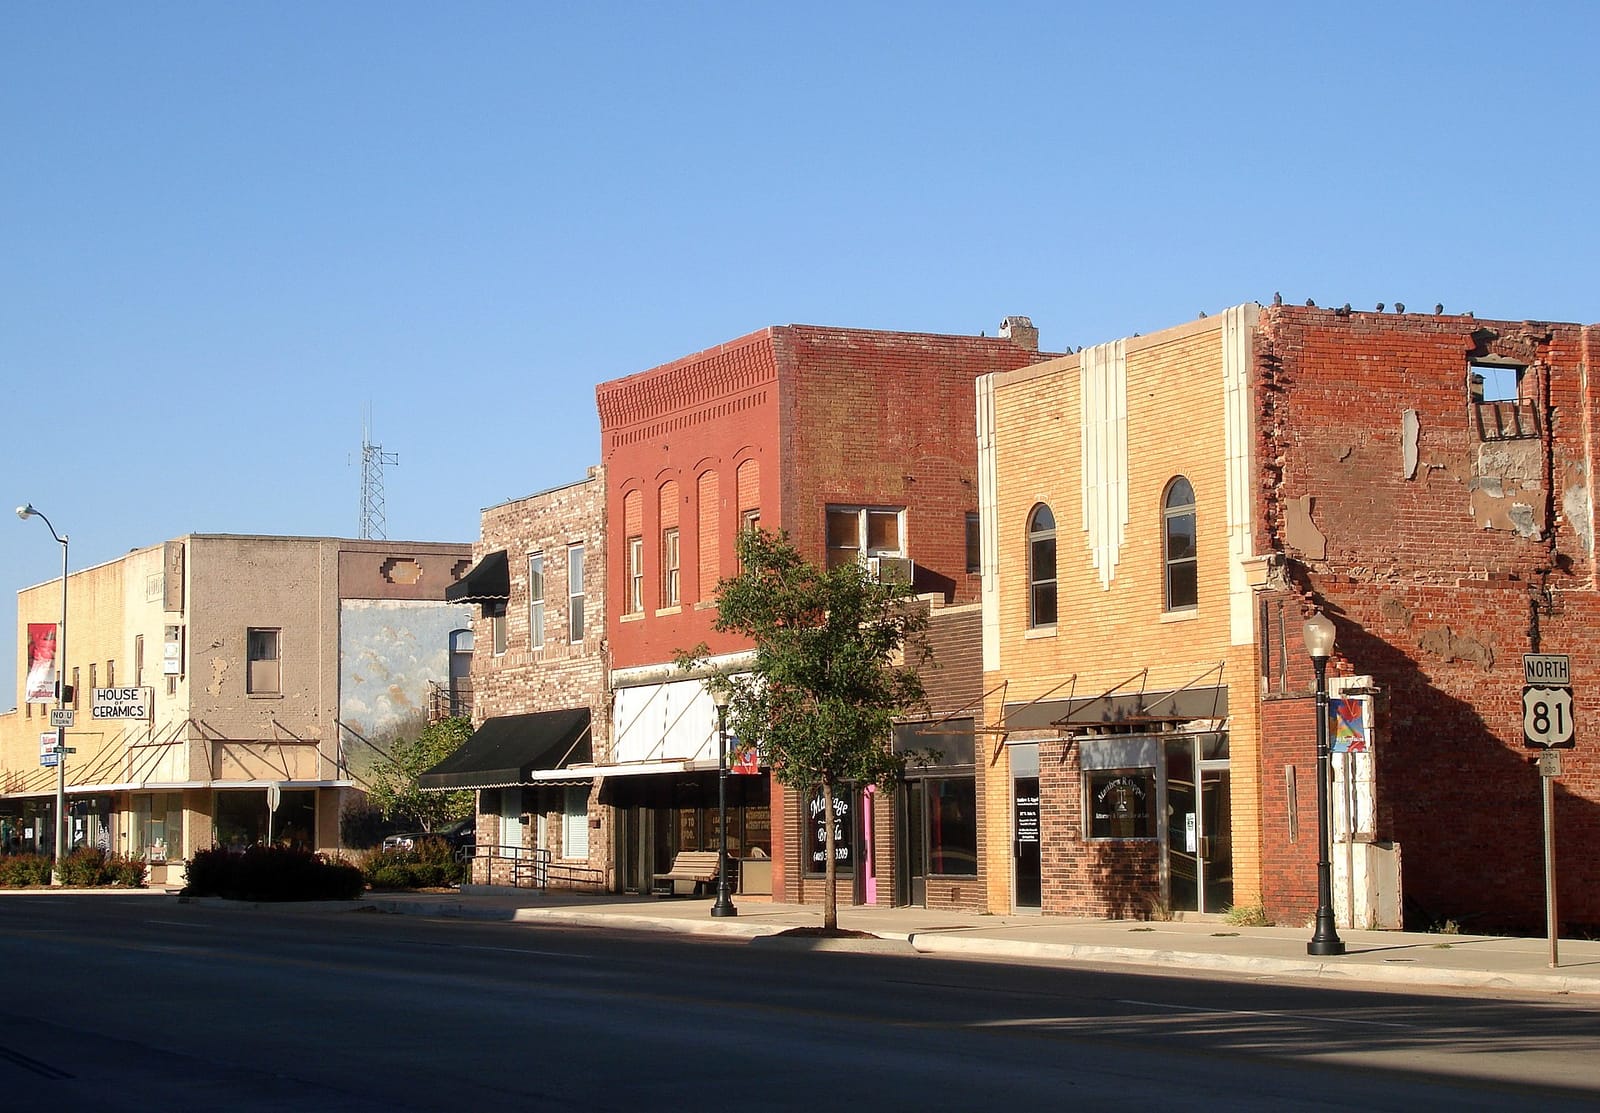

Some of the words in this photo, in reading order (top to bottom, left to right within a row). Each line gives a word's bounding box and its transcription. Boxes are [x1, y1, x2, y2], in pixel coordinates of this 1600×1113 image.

[1527, 661, 1567, 678] NORTH
[97, 689, 139, 701] HOUSE
[92, 706, 144, 717] CERAMICS
[1533, 701, 1563, 735] 81
[810, 795, 849, 819] Maage
